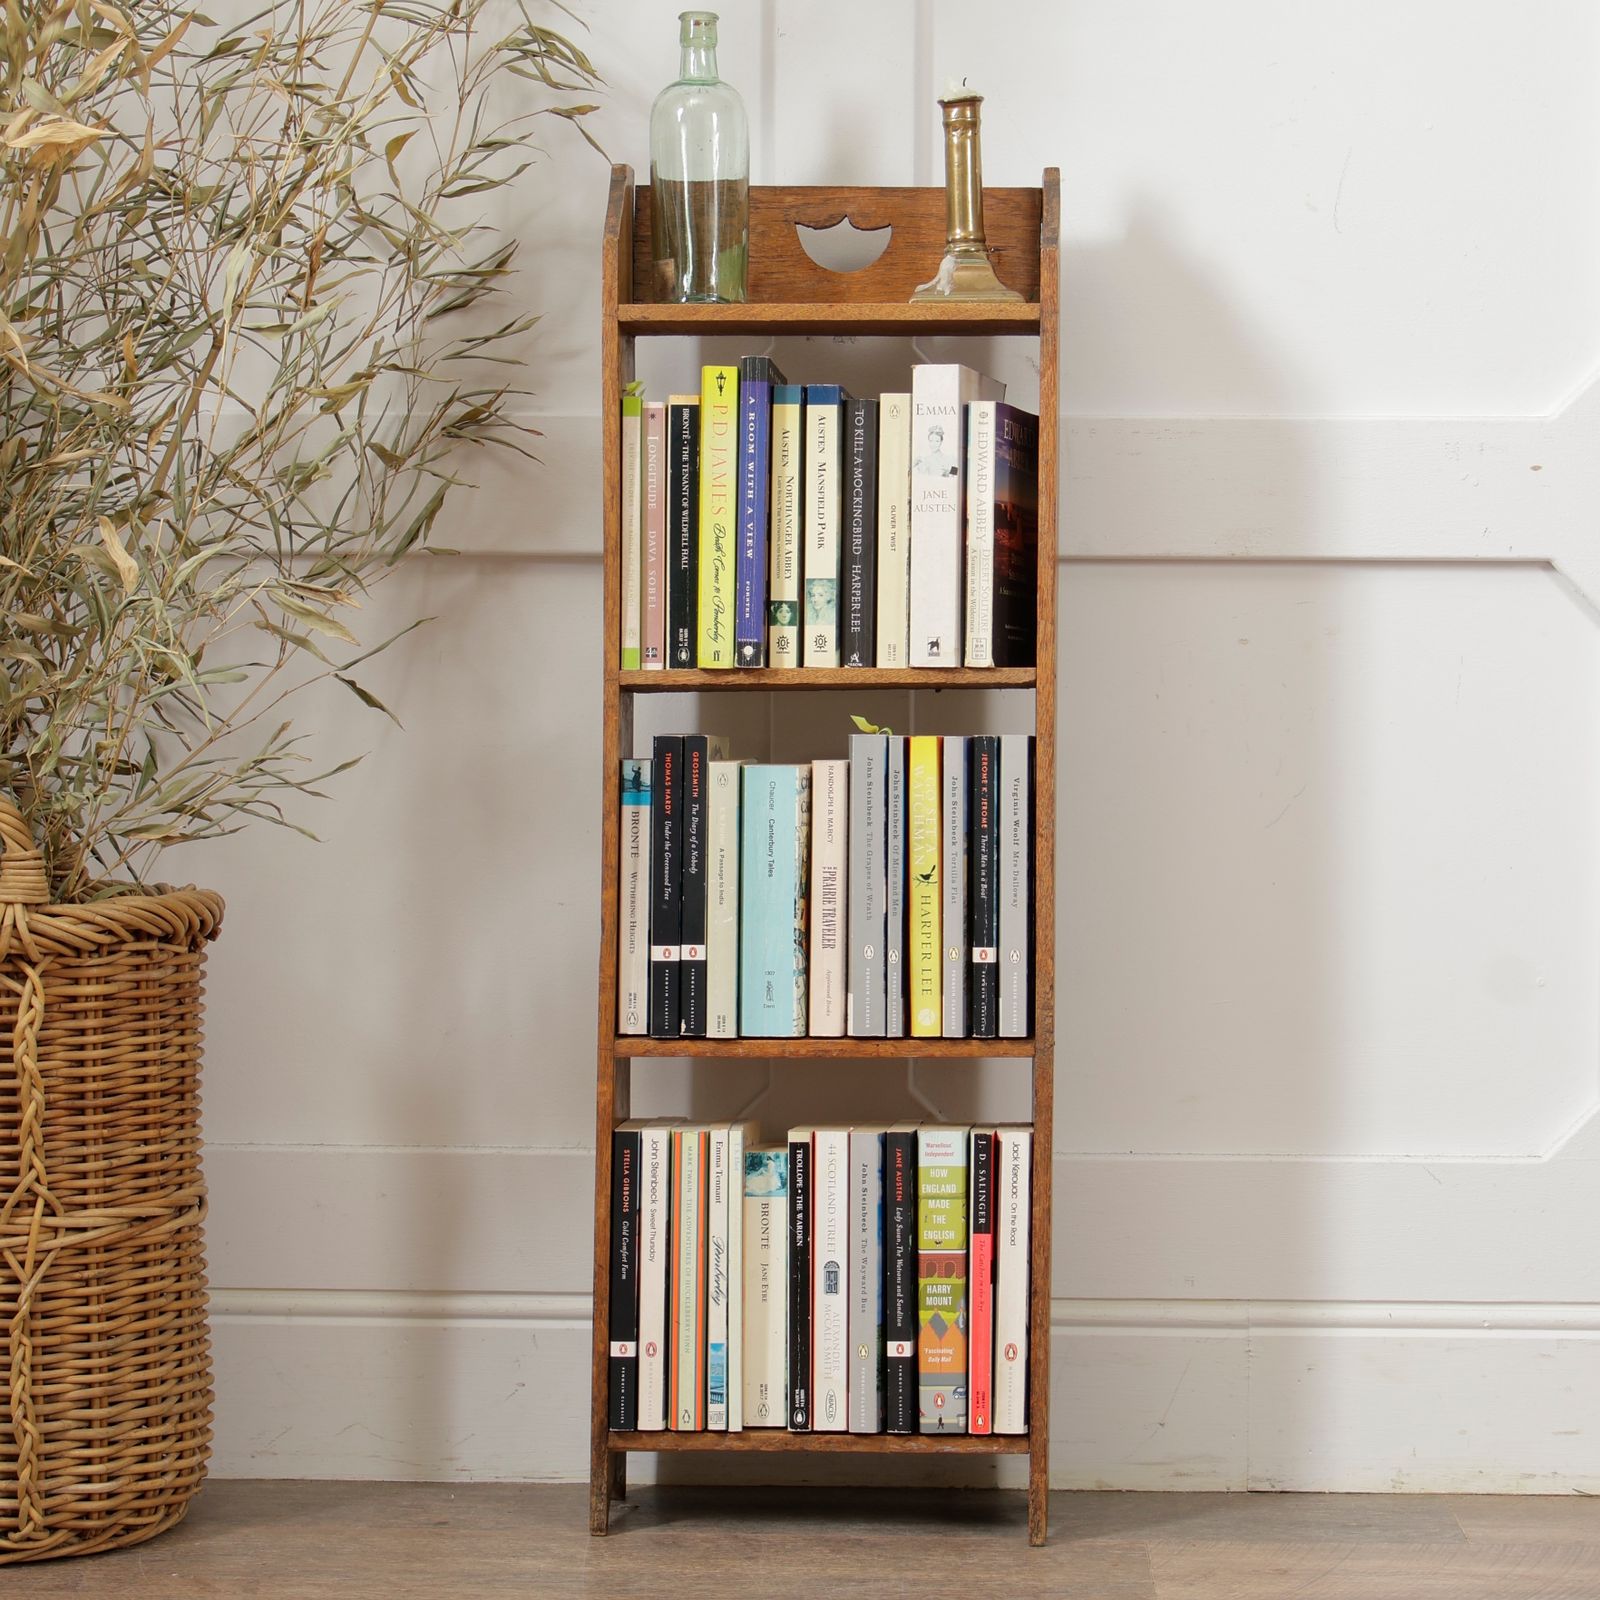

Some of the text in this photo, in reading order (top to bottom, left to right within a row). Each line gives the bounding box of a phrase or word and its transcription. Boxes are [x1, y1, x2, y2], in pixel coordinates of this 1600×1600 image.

[748, 396, 756, 405] A
[915, 403, 957, 416] EMMA
[747, 412, 756, 454] ROOM
[682, 446, 690, 462] THE
[681, 464, 689, 496] TENANT
[710, 446, 728, 516] JAMES
[746, 462, 755, 499] WITH
[817, 414, 827, 550] AUSTEN MANSFIELD PARK
[975, 432, 989, 542] EDWARD ABBEY
[681, 498, 689, 508] OF
[781, 428, 795, 582] AUSTEN NORTHANGER ABBEY
[913, 503, 956, 513] AUSTEN
[923, 490, 948, 500] JANE
[648, 436, 659, 609] LONGITUDE DAVA SOBEL
[746, 506, 754, 515] A
[850, 409, 864, 633] TO KILL A MOCKINGBIRD HARPER LEE
[681, 509, 689, 548] WILDFELL
[713, 522, 727, 556] Death
[746, 522, 754, 560] VIEW
[681, 549, 689, 571] HALL
[713, 556, 726, 583] Comes
[713, 584, 722, 594] to
[706, 595, 726, 644] Pemberley
[664, 752, 672, 786] THOMAS
[692, 751, 700, 798] GROSSMITH
[866, 756, 874, 779] John
[892, 769, 900, 792] John
[980, 753, 988, 785] JEROME
[827, 765, 835, 808] RANDOLPH
[951, 775, 959, 798] John
[980, 786, 988, 795] K.
[664, 788, 672, 815] HARDY
[692, 803, 700, 815] The
[866, 781, 874, 827] Steinbeck
[980, 797, 988, 829] JEROME
[690, 816, 700, 835] Diary
[892, 793, 900, 841] Steinbeck
[912, 765, 925, 866] WATCHMAN
[951, 800, 959, 847] Steinbeck
[664, 820, 672, 839] Under
[690, 835, 699, 845] of
[767, 780, 777, 879] Chaucer Canterbury Tales
[826, 816, 834, 844] MARCY
[980, 834, 988, 852] Three
[1011, 776, 1021, 909] Virginia Woolf Mrs Dalloway
[664, 841, 672, 850] the
[892, 844, 900, 856] Of
[663, 852, 672, 885] Greenwood
[690, 850, 699, 875] Nobody
[717, 854, 726, 881] Passage
[864, 849, 873, 880] Grapes
[892, 858, 900, 877] Mice
[980, 853, 988, 868] Men
[629, 871, 638, 918] WUTHERING
[719, 881, 726, 889] to
[866, 882, 873, 891] of
[980, 883, 988, 899] Boat
[821, 871, 837, 950] PRAIRIE TRAVELER
[628, 920, 638, 954] HEIGHTS
[920, 894, 932, 995] HARPER LEE
[895, 1147, 903, 1168] JANE
[860, 1163, 868, 1185] John
[895, 1170, 903, 1202] AUSTEN
[930, 1168, 949, 1178] HOW
[978, 1139, 987, 1225] J. D. SALINGER
[648, 1137, 660, 1263] John Steinbeck Sweet Thursday
[795, 1148, 804, 1247] TROLLOPE THE WARDEN
[826, 1143, 836, 1256] 44 SCOTLAND STREET
[921, 1183, 957, 1193] ENGLAND
[1009, 1141, 1021, 1247] Jack Kerouac On the Road
[620, 1149, 631, 1281] STELLA GIBBONS Cold Comfort Farm
[860, 1187, 869, 1233] Steinbeck
[894, 1207, 904, 1222] Lady
[927, 1199, 951, 1209] MADE
[711, 1140, 727, 1306] Emma Tennant Pemberley
[932, 1215, 947, 1225] THE
[685, 1215, 693, 1265] ADVENTURES
[860, 1238, 868, 1255] The
[895, 1223, 903, 1245] Susan,
[923, 1230, 955, 1240] ENGLISH
[895, 1245, 903, 1257] The
[760, 1263, 769, 1282] JANE
[859, 1256, 868, 1295] Wayward
[895, 1258, 903, 1284] Watsons
[760, 1283, 769, 1304] EYRE
[926, 1284, 952, 1294] HARRY
[926, 1296, 953, 1306] MOUNT
[684, 1279, 692, 1332] HUCKLEBERRY
[896, 1298, 904, 1327] Sanditon
[822, 1346, 832, 1380] SMITH
